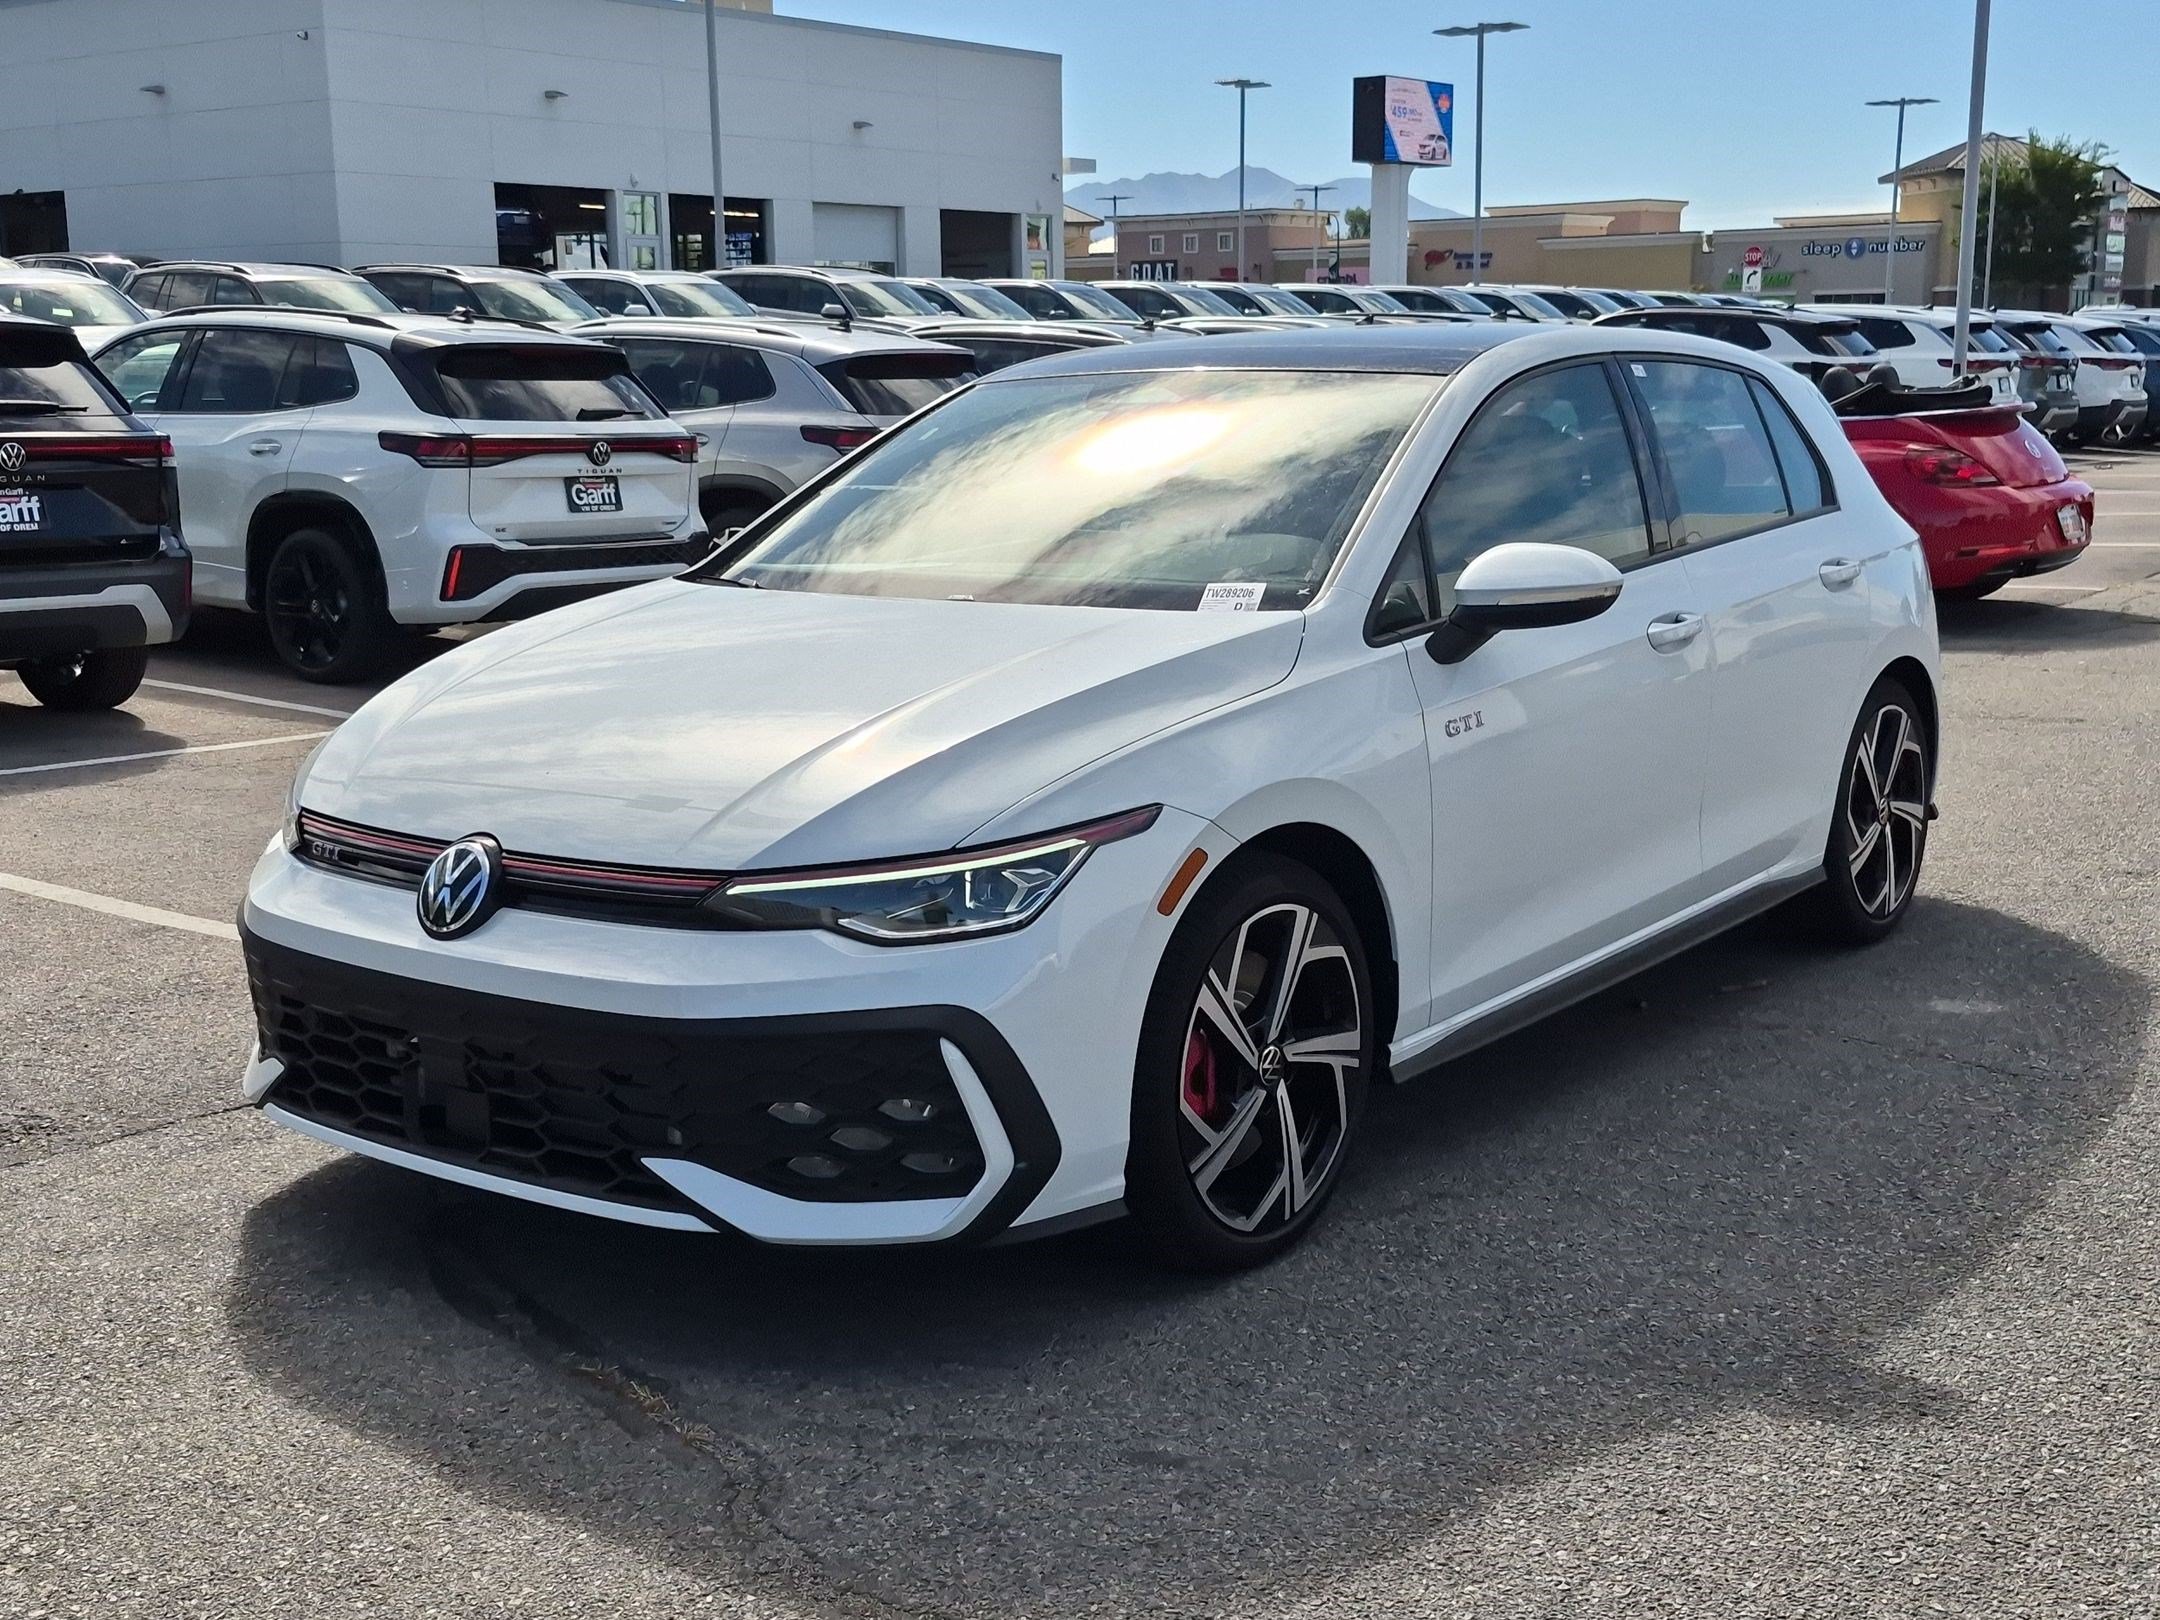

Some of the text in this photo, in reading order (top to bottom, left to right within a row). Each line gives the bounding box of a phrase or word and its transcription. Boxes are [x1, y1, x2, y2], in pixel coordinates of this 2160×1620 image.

[1745, 252, 1762, 262] STOP
[1801, 241, 1841, 258] sleep
[572, 483, 616, 505] Garff
[0, 495, 40, 523] arff
[1444, 710, 1485, 738] GTI
[312, 841, 341, 861] GTI
